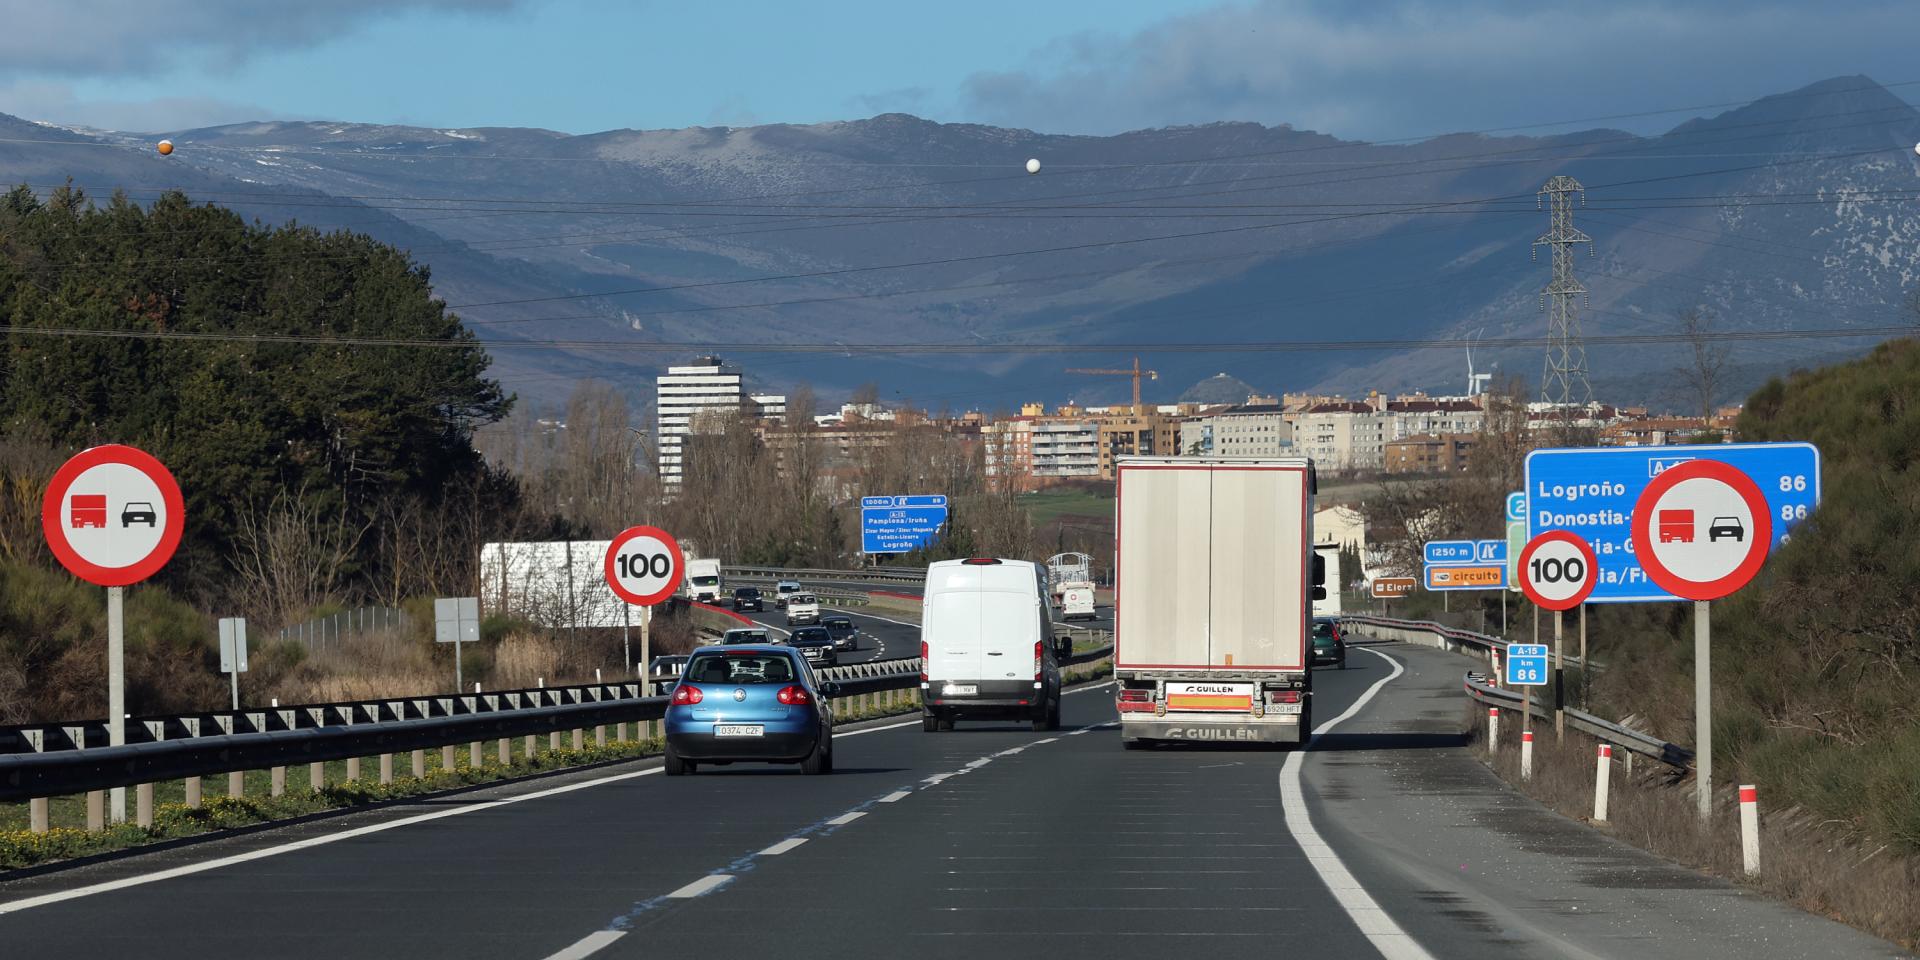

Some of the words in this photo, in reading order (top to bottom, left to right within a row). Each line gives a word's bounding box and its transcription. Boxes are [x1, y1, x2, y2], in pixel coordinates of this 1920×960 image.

[1539, 481, 1625, 501] Logroño
[1779, 475, 1807, 492] 86
[1539, 509, 1634, 527] Donostia-
[1781, 504, 1807, 521] 86
[868, 517, 927, 525] Pamplona/Iruña
[882, 541, 913, 549] Logroño
[1432, 548, 1456, 557] 1250
[617, 553, 670, 579] 100
[1531, 557, 1585, 583] 100
[1453, 571, 1499, 581] circuito
[1517, 646, 1538, 655] A-15
[1517, 669, 1537, 680] 86
[721, 727, 741, 735] 0374
[1187, 728, 1258, 740] GUILLÉN
